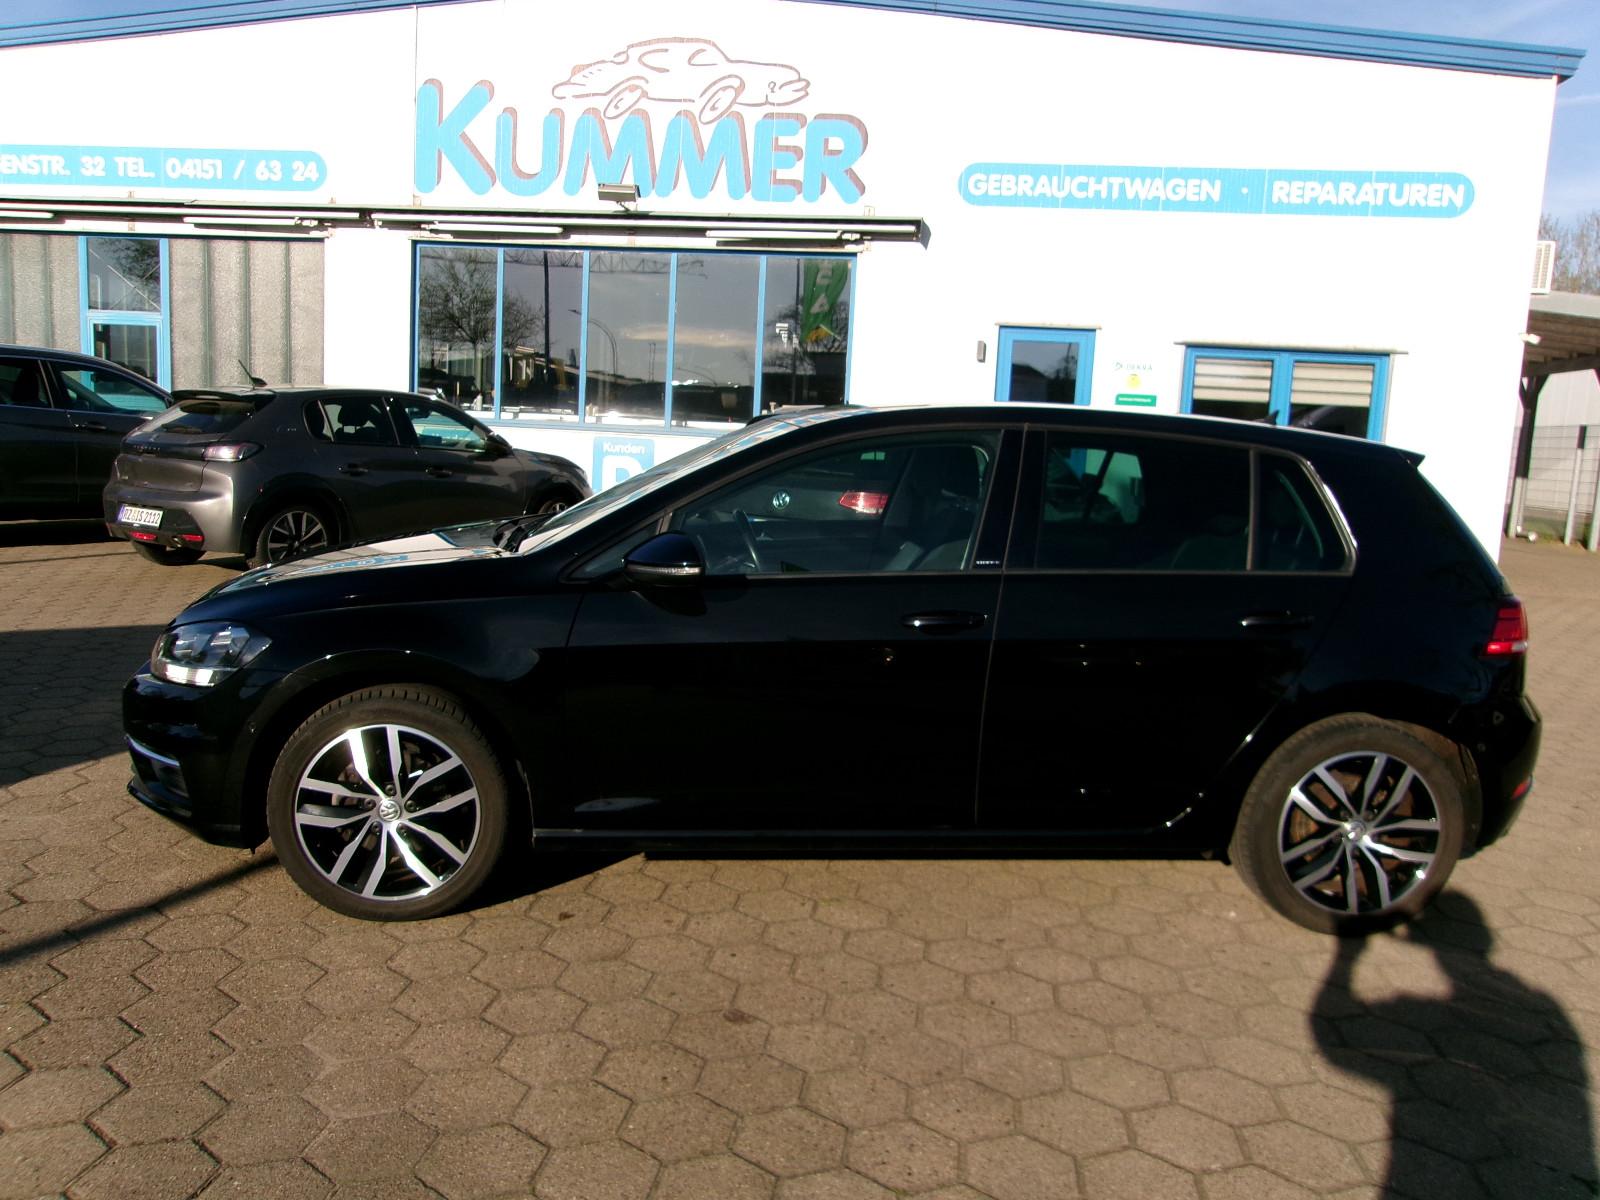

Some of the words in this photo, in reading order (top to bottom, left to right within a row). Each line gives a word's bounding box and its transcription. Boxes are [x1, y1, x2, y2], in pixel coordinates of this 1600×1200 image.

[414, 79, 868, 204] KUMMER
[80, 155, 105, 177] 32
[115, 156, 155, 178] TEL.
[166, 157, 223, 180] 04151
[255, 159, 282, 182] 63
[292, 160, 319, 182] 24
[967, 173, 1221, 202] GEBRAUCHTWAGEN
[1271, 180, 1465, 208] REPARATUREN
[603, 442, 646, 455] Kunden
